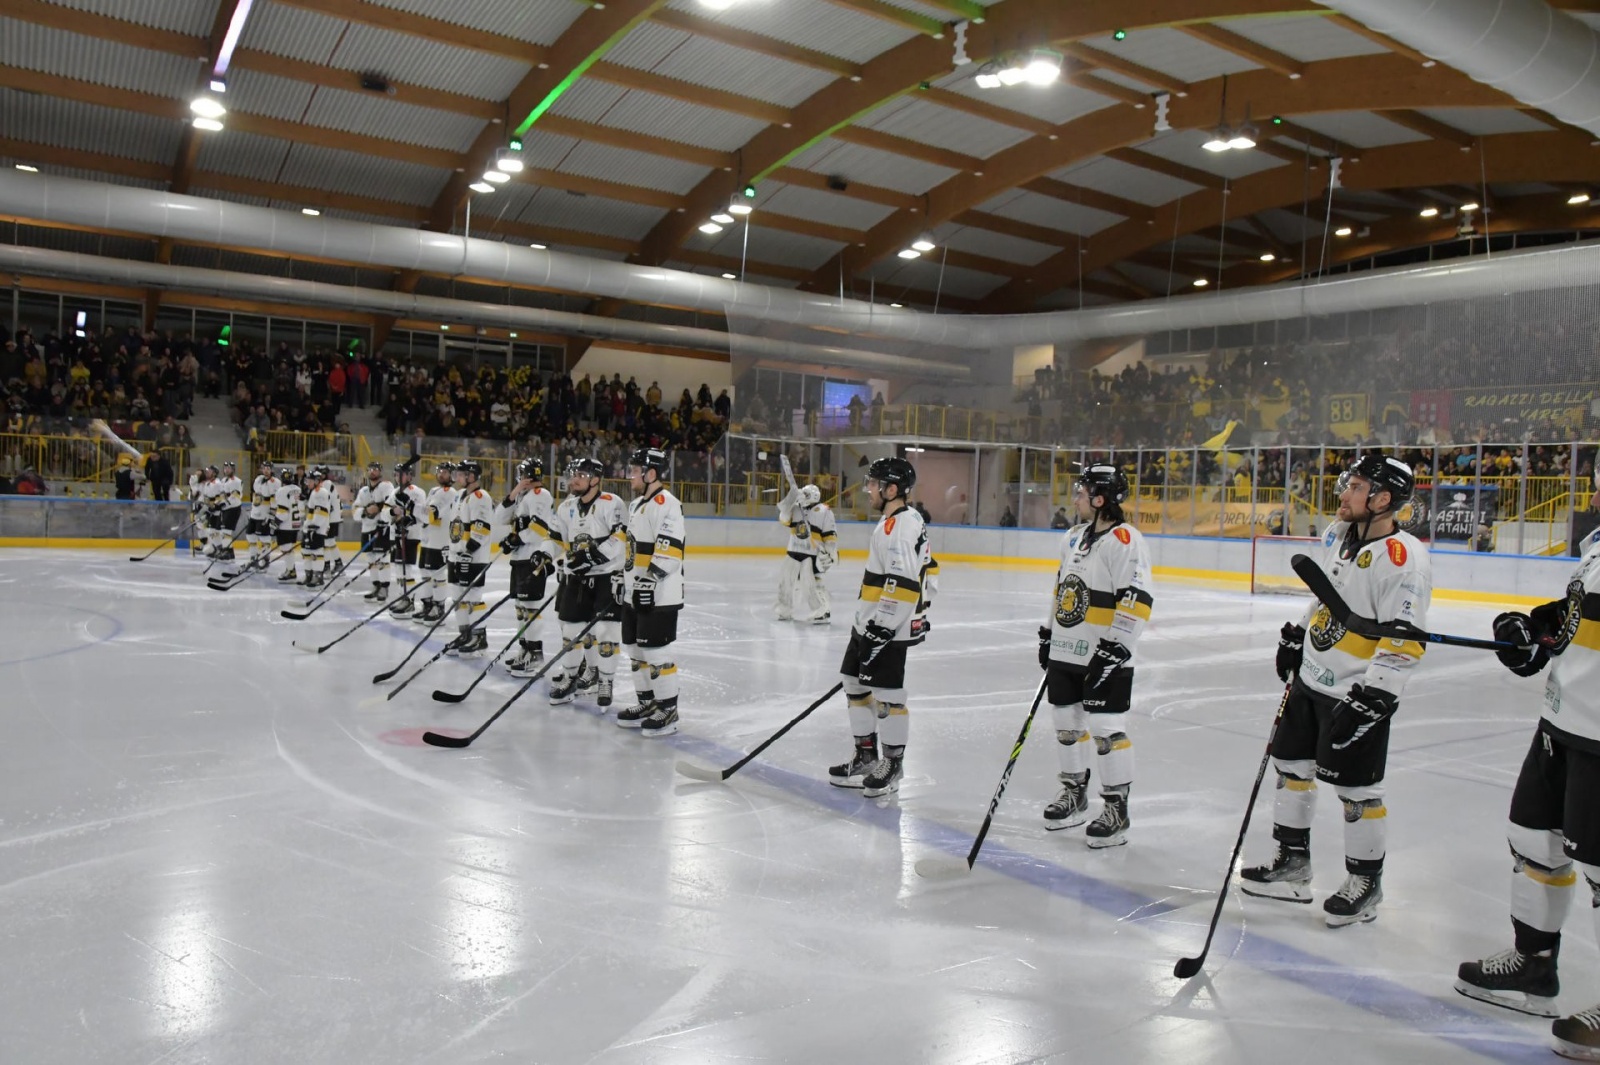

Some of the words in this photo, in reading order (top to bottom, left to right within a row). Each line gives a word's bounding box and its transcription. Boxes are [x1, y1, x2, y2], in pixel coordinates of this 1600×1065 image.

[1464, 393, 1535, 407] RAGAZZI
[1540, 390, 1594, 404] DELLA
[1331, 401, 1352, 421] 88
[1215, 512, 1264, 525] FOREVR
[1428, 509, 1486, 523] ASTII
[883, 577, 897, 593] 13
[1121, 590, 1138, 609] 21
